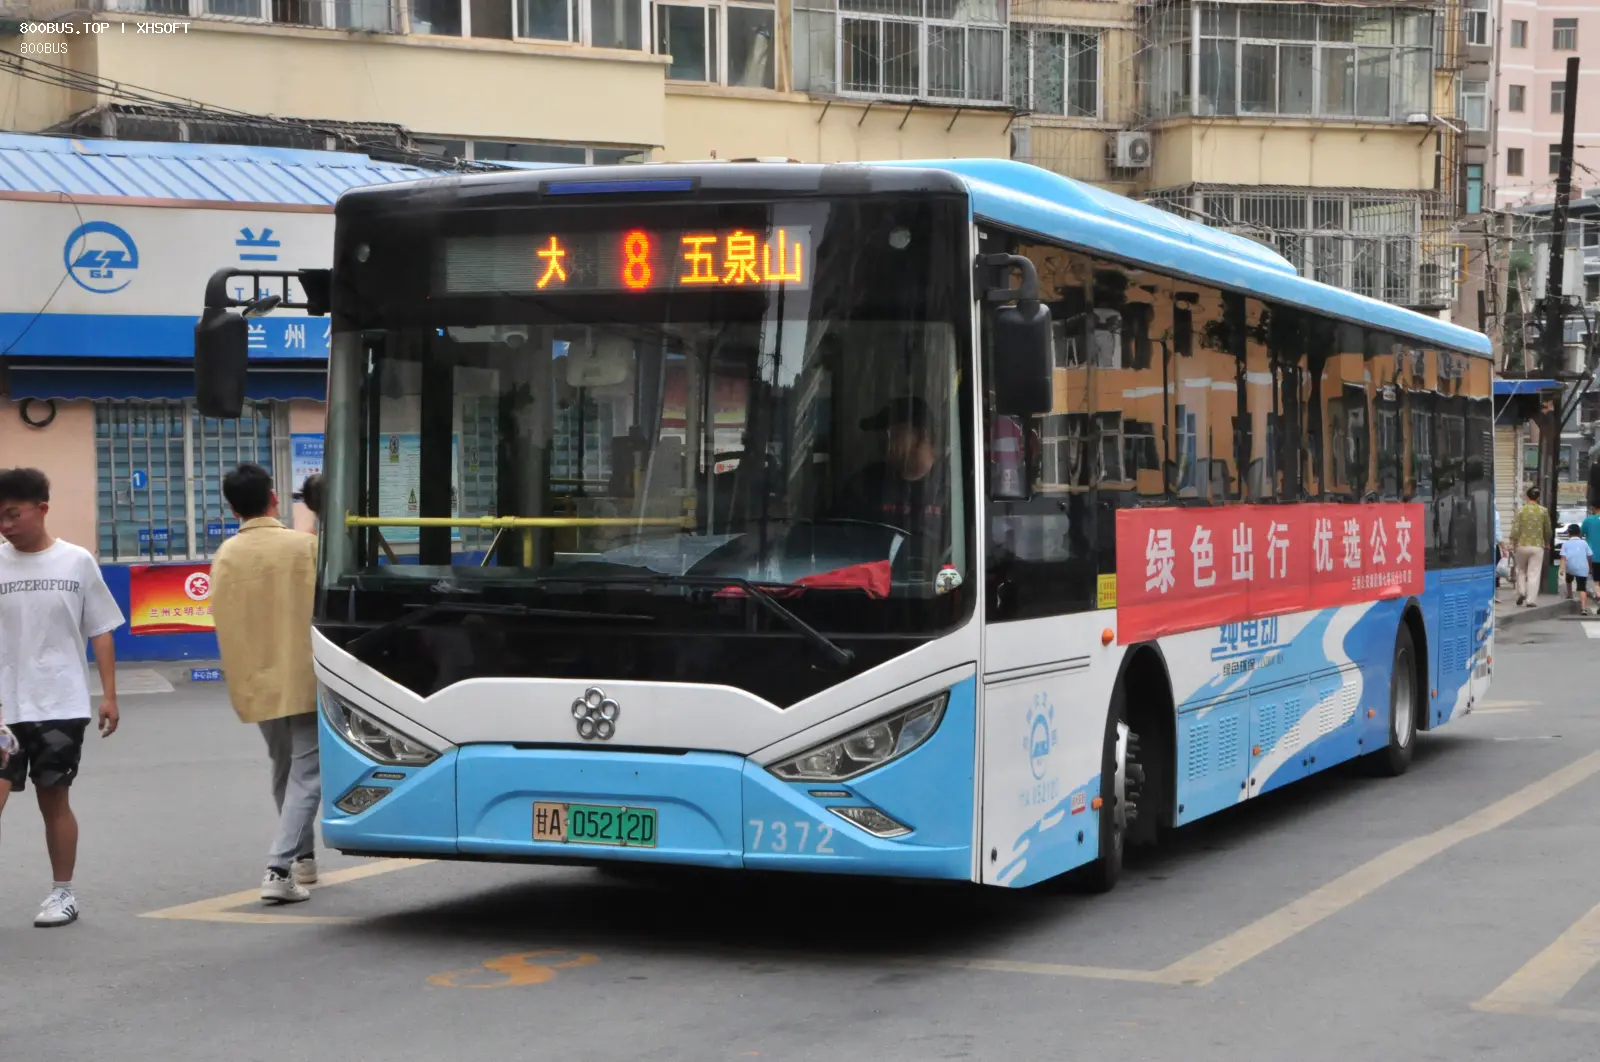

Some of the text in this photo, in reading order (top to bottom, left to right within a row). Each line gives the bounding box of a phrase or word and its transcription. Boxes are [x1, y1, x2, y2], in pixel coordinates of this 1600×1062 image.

[622, 230, 652, 290] 8
[680, 228, 803, 285] 五泉山
[1145, 515, 1413, 594] 绿色出行 优选公交
[1219, 616, 1278, 651] 纯电动
[1223, 658, 1256, 676] 绿色环保
[748, 820, 836, 853] 7372
